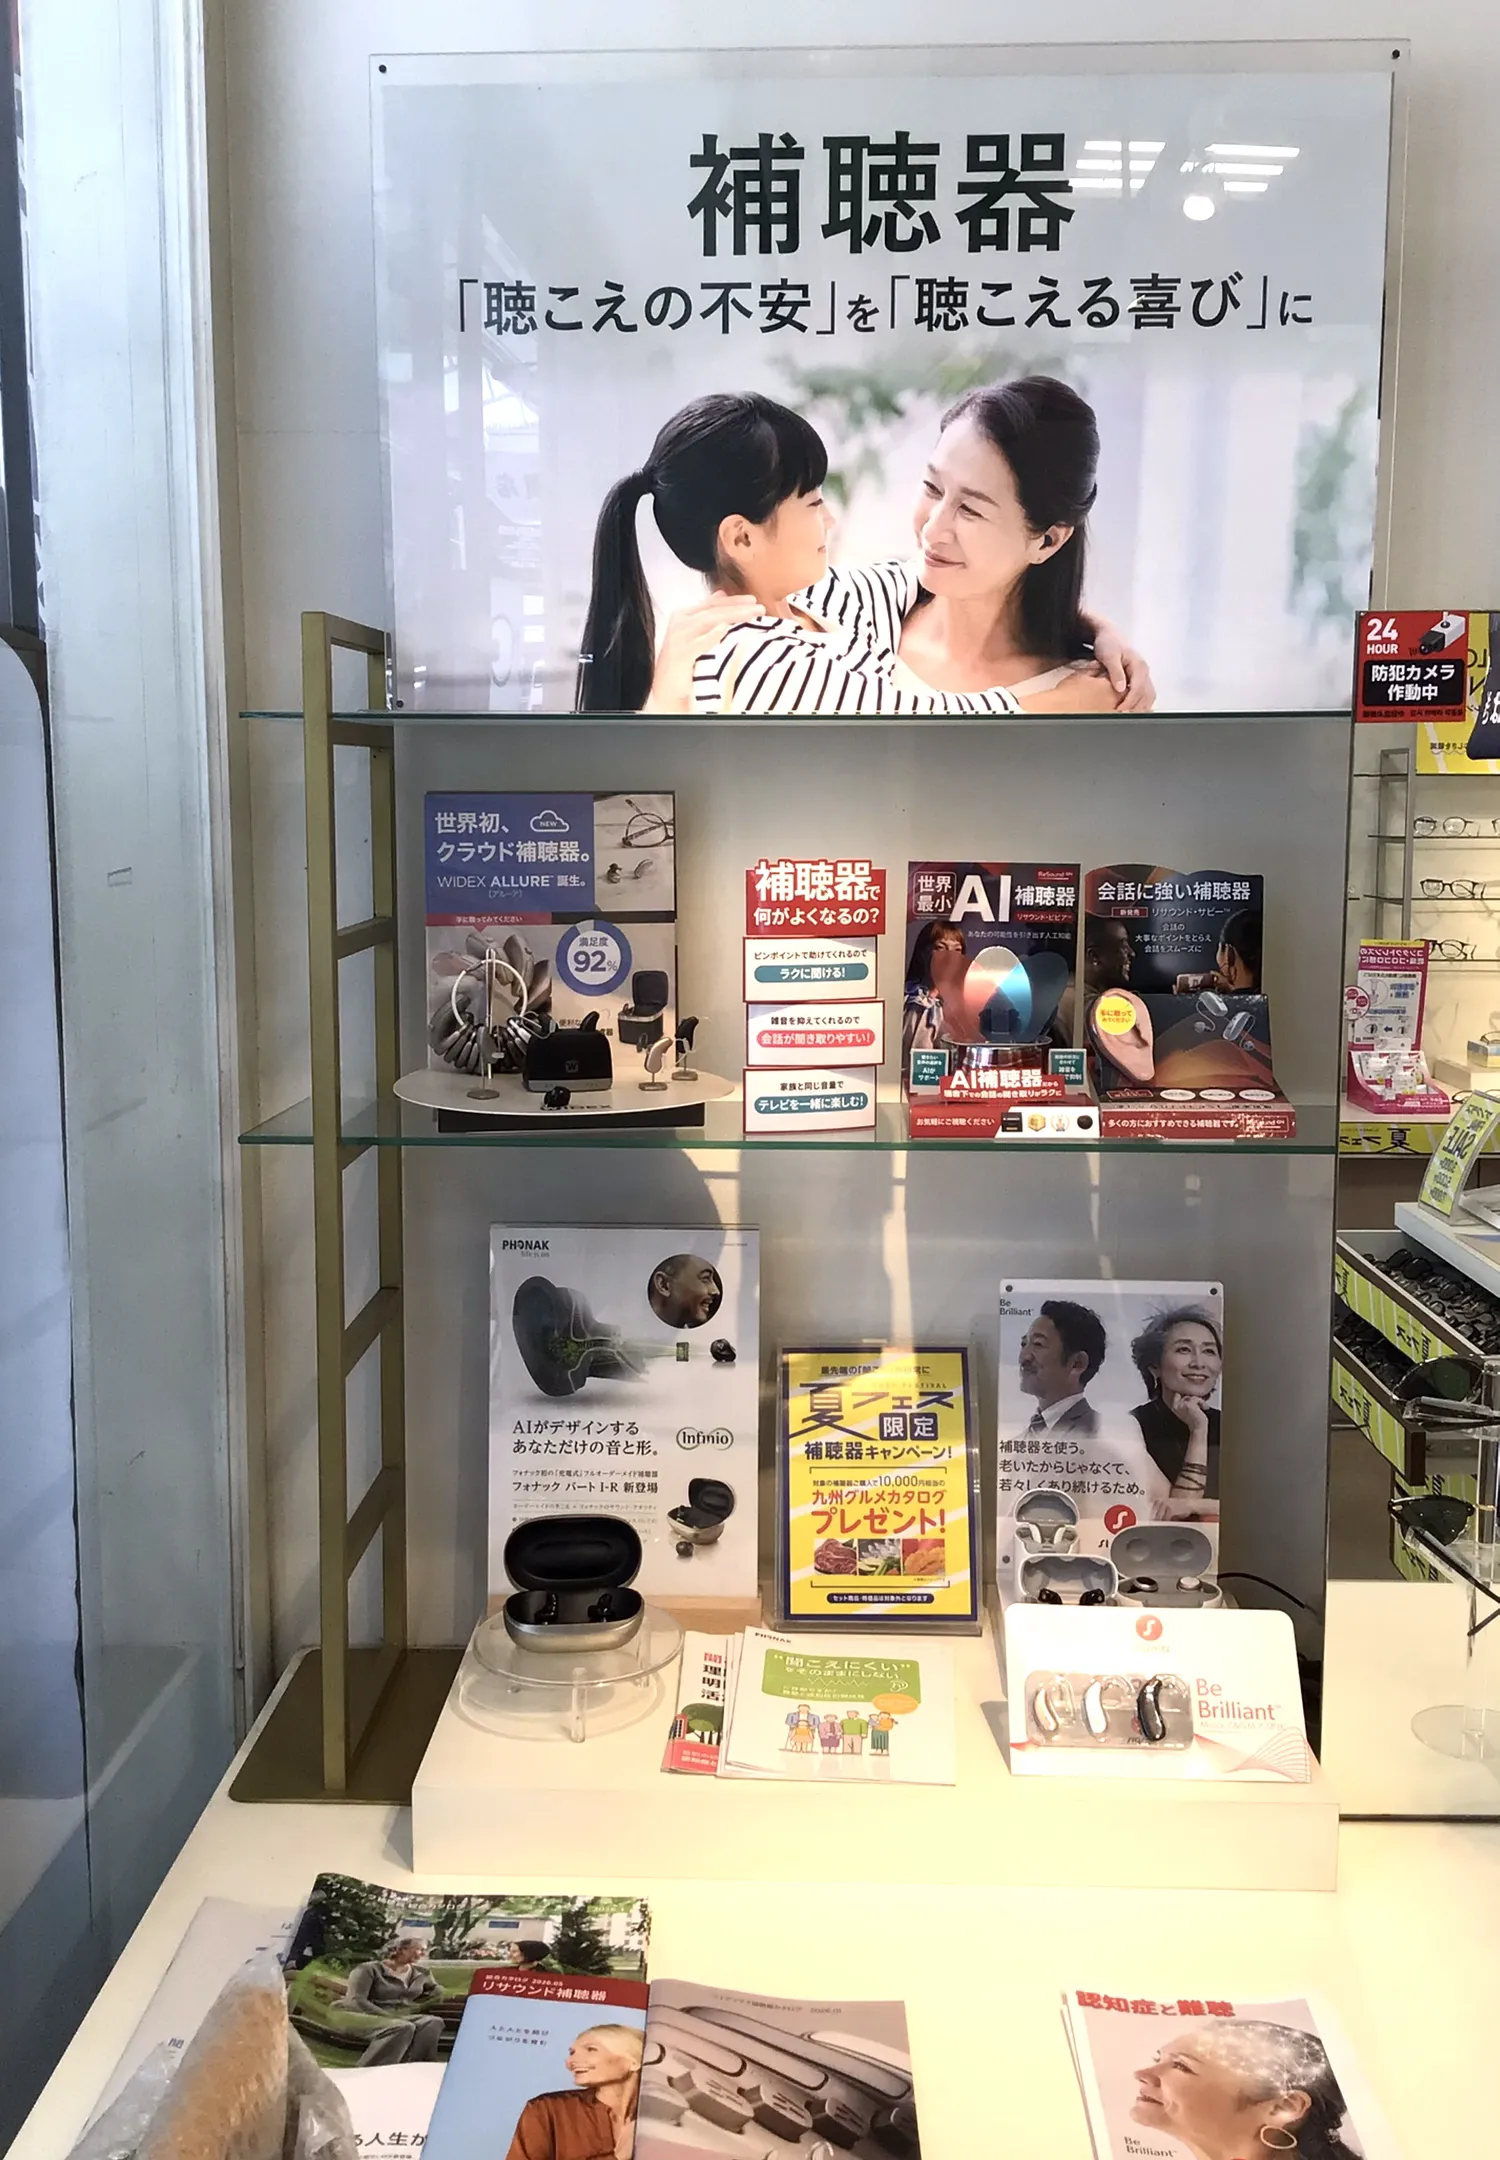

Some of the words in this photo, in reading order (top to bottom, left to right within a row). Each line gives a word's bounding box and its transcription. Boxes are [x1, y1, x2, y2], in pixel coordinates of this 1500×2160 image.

[687, 131, 1076, 256] 補聴器
[456, 272, 1314, 336] 「聴こえの不安」を「聴こえる喜び」に
[1367, 618, 1398, 641] 24
[1367, 643, 1398, 655] HOUR
[1371, 664, 1456, 683] 防犯カメラ
[1387, 684, 1438, 702] 作動中
[434, 812, 510, 836] 世界初、
[436, 841, 590, 863] クラウド補聴器。
[437, 875, 487, 888] WIDEX
[557, 875, 587, 888] 誕生。
[755, 861, 881, 902] 補聴器で
[917, 875, 953, 894] 世界
[949, 874, 1012, 924] AI
[1014, 885, 1077, 908] 補聴器
[1098, 881, 1251, 901] 会話に強い補聴器
[753, 907, 880, 926] 何がよくなるの?
[1162, 923, 1185, 932] 会話の
[578, 936, 609, 948] 満足度
[1135, 933, 1213, 943] 大事なポイントをとらえ
[753, 949, 868, 961] ピンポイントで助けてくれるので
[1144, 943, 1202, 953] 会話をスムーズに
[573, 950, 618, 974] 92%
[770, 1015, 861, 1026] 雑音を抑えてくれるので
[779, 1080, 845, 1092] 家族と同じ音量で
[502, 1239, 549, 1251] PHONAK
[1000, 1298, 1011, 1307] Be
[789, 1382, 954, 1441] 夏フェス
[512, 1419, 640, 1436] AIがデザインする
[882, 1416, 936, 1438] 限定
[682, 1431, 729, 1446] Infinio
[999, 1440, 1086, 1455] 補聴器を使う。
[512, 1439, 659, 1457] あなただけの音と形。
[804, 1441, 952, 1461] 補聴器キャンペーン!
[999, 1459, 1131, 1476] 老いたからじゃなくて、
[512, 1481, 561, 1493] フォナック
[600, 1481, 619, 1493] I-R
[623, 1481, 659, 1494] 新登場
[999, 1478, 1147, 1496] 若々しくあり続けるため。
[811, 1489, 948, 1506] 九州グルメカタログ
[810, 1507, 946, 1535] プレゼント!
[1196, 1678, 1222, 1697] Be
[482, 1981, 608, 2002] リサウンド補聴器
[1076, 1990, 1236, 2017] 認知症と難聴
[1124, 2136, 1141, 2147] Be
